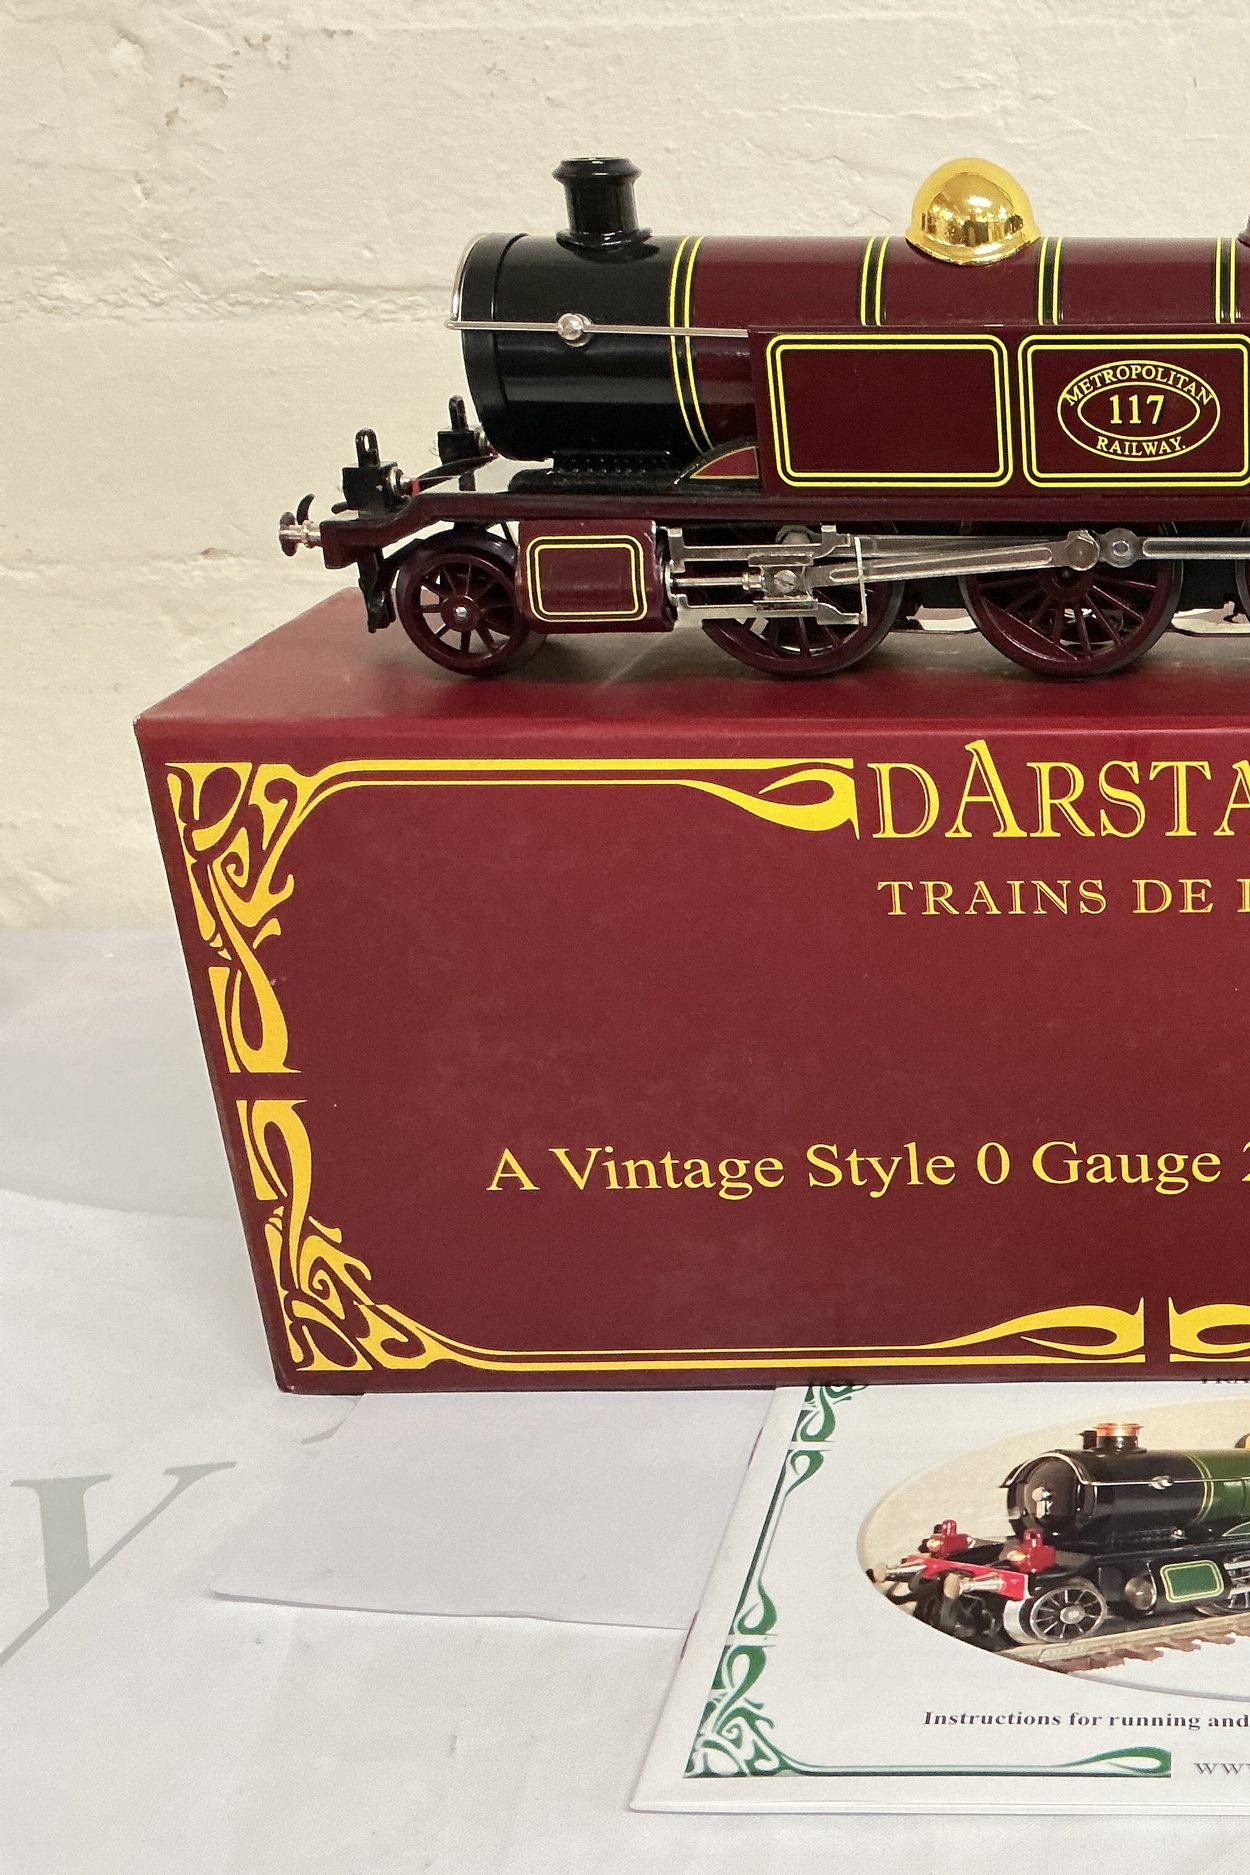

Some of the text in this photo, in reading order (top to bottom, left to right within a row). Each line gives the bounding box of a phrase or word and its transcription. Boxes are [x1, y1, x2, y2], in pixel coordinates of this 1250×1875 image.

[1062, 364, 1214, 406] METROPOLITAN
[1109, 393, 1165, 425] 117
[877, 880, 1107, 916] TRAINS
[1132, 878, 1213, 914] DE
[486, 1147, 540, 1192] A
[548, 1145, 785, 1201] Vintage
[807, 1141, 956, 1199] Style
[1032, 1138, 1222, 1196] Gauge
[922, 1710, 1062, 1727] Instructions
[1068, 1711, 1103, 1727] for
[1108, 1713, 1201, 1732] running
[1207, 1714, 1250, 1729] and
